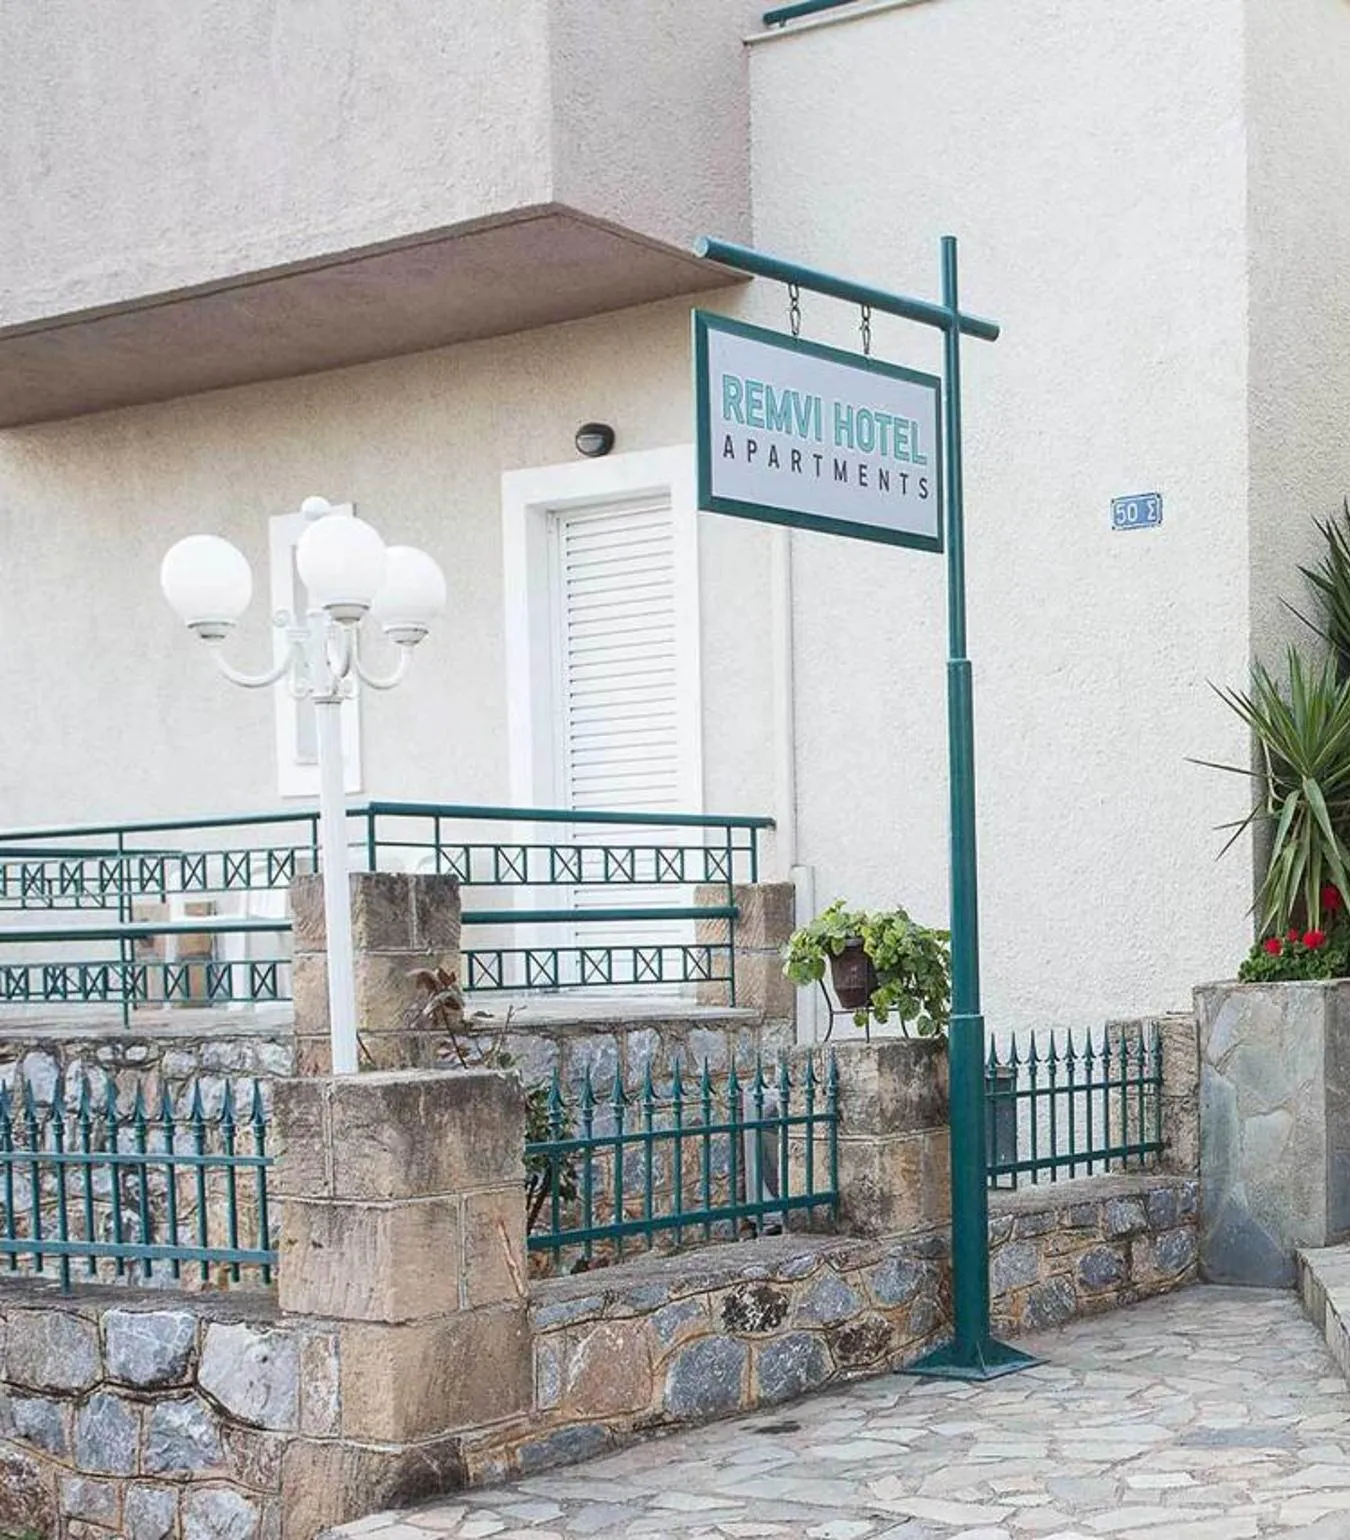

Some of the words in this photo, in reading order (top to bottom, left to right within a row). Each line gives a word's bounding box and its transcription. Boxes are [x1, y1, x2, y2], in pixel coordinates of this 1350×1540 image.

[722, 374, 822, 442] REMVI
[834, 402, 928, 465] HOTEL
[723, 434, 929, 499] APARTMENTS
[1116, 503, 1138, 524] 50
